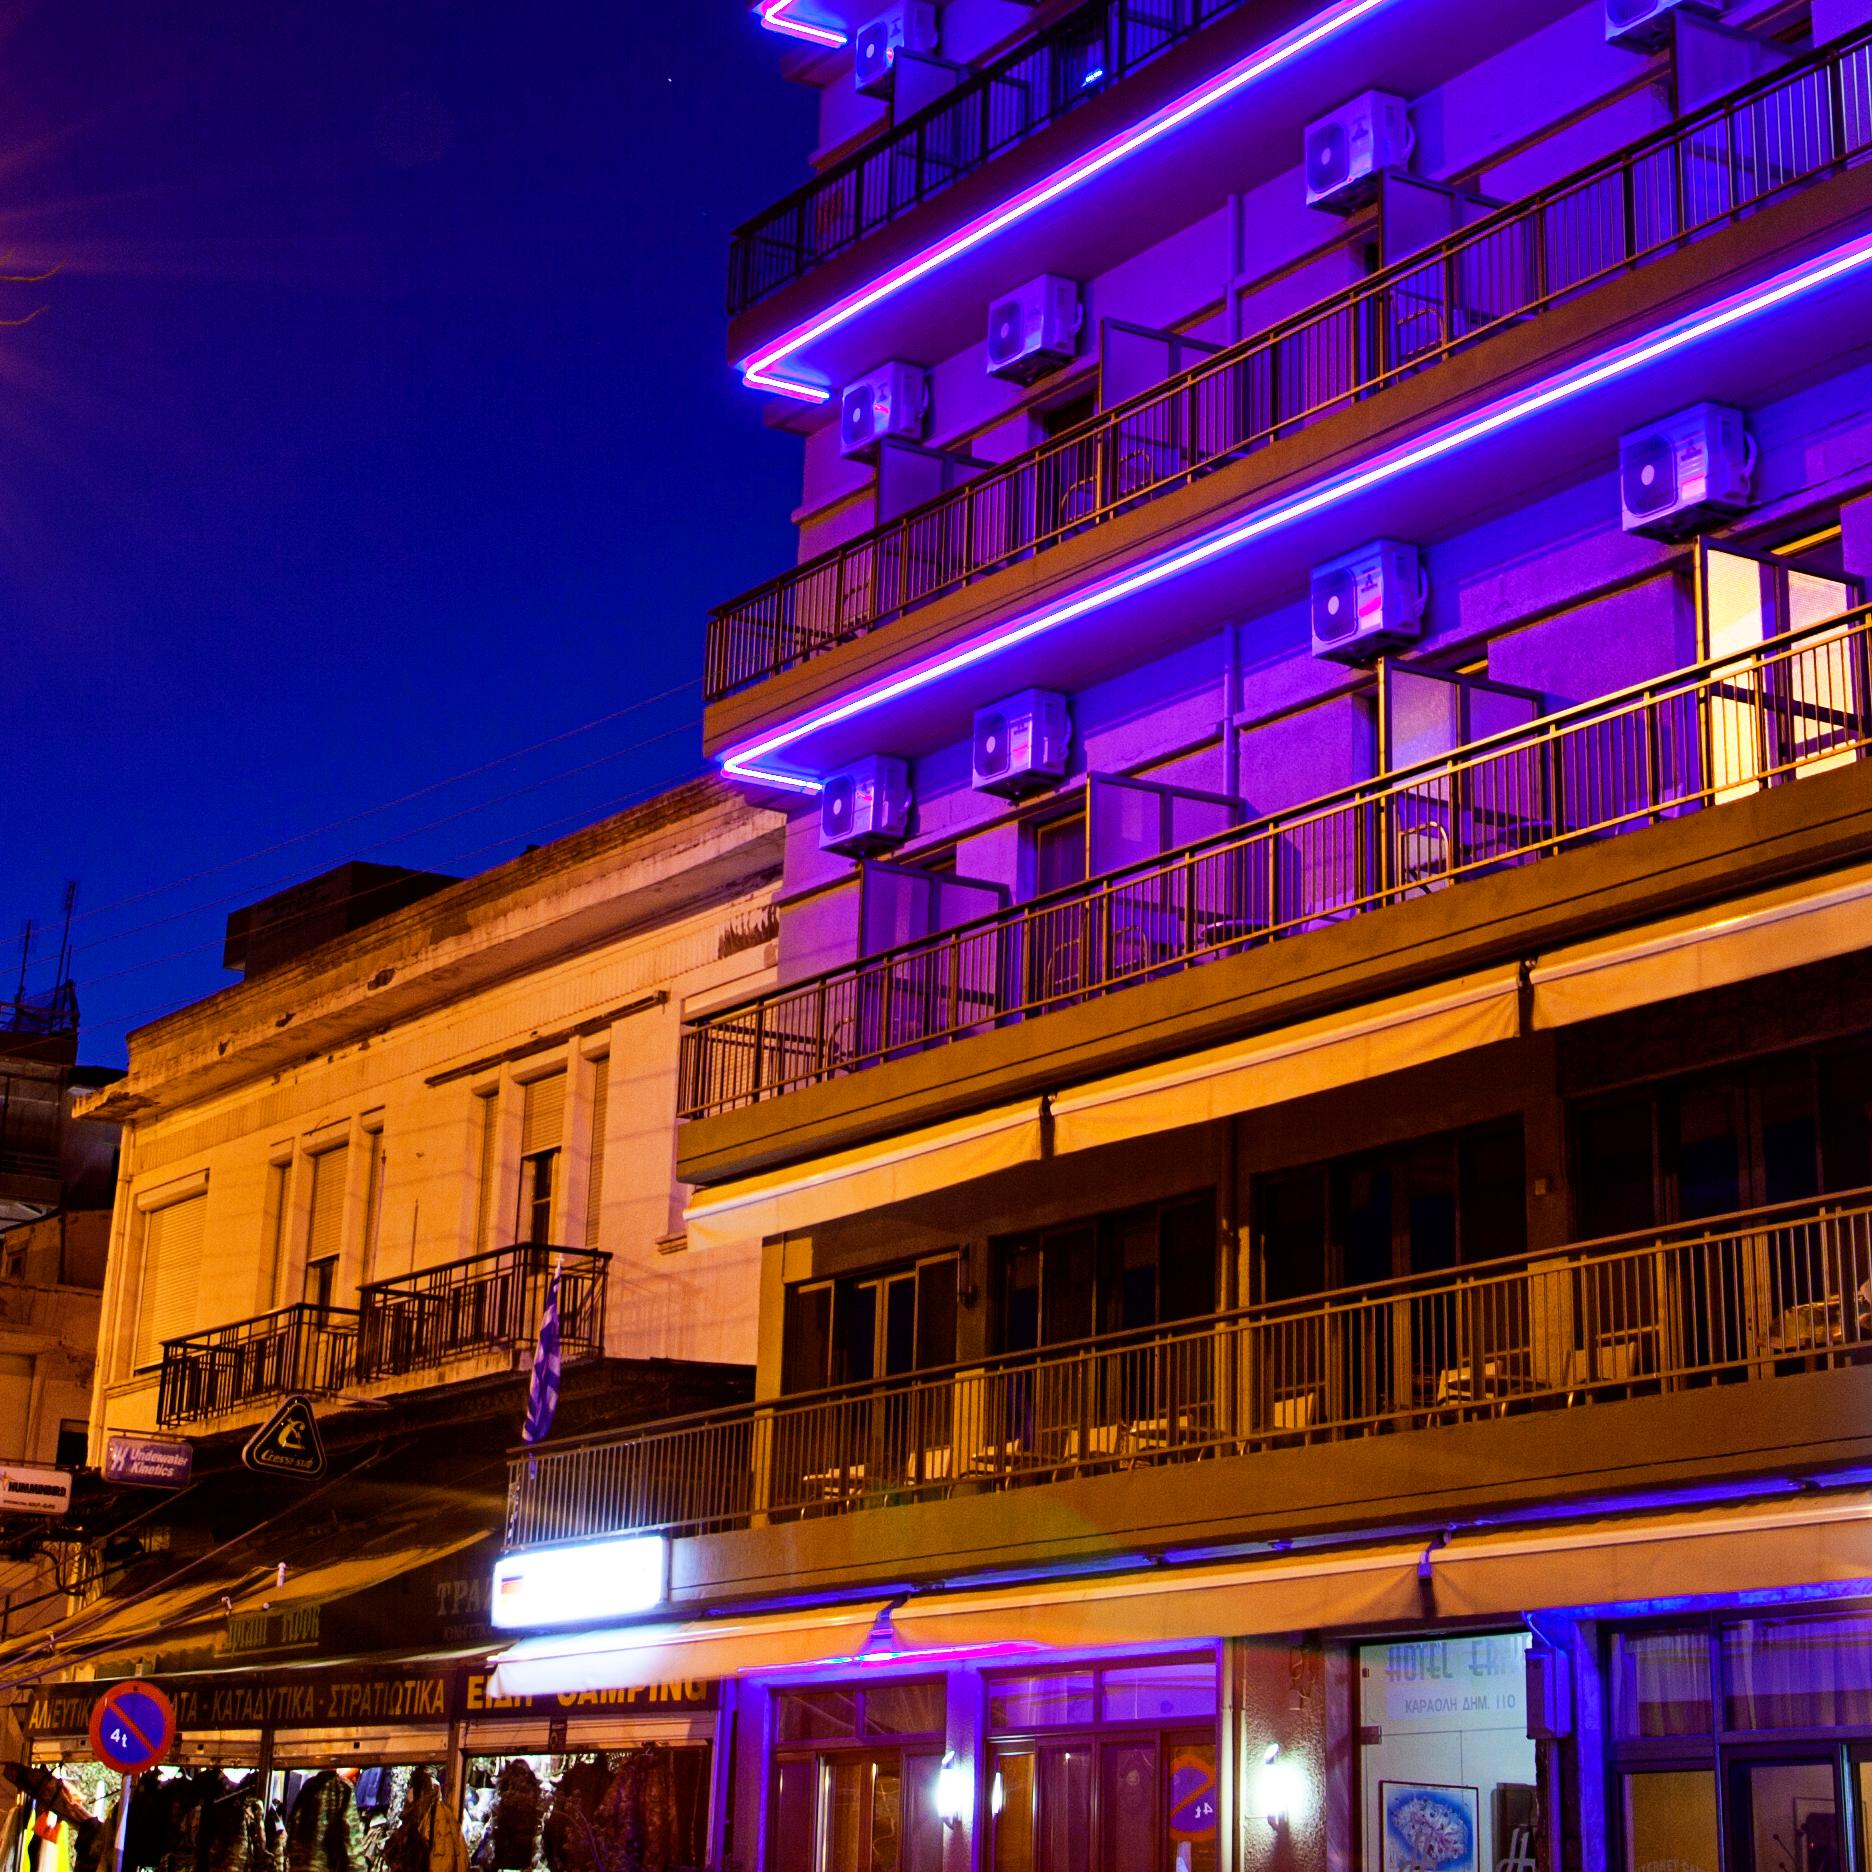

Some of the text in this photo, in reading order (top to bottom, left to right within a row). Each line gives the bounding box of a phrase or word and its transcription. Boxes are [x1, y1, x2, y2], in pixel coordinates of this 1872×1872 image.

[131, 1448, 188, 1466] Underwater
[130, 1461, 174, 1477] Kinetics
[29, 1696, 95, 1728] ΑΛΙΕΥΤΙΚ
[211, 1685, 314, 1722] ΚΑΤΑΔΥΤΙΚΑ
[328, 1678, 445, 1718] ΣΤΡΑΤΙΩΤΙΚΑ
[1405, 1697, 1458, 1714] ΚΑΡΑΟΛΗ
[1463, 1695, 1490, 1711] ΔΗΜ.
[110, 1728, 128, 1748] 4t
